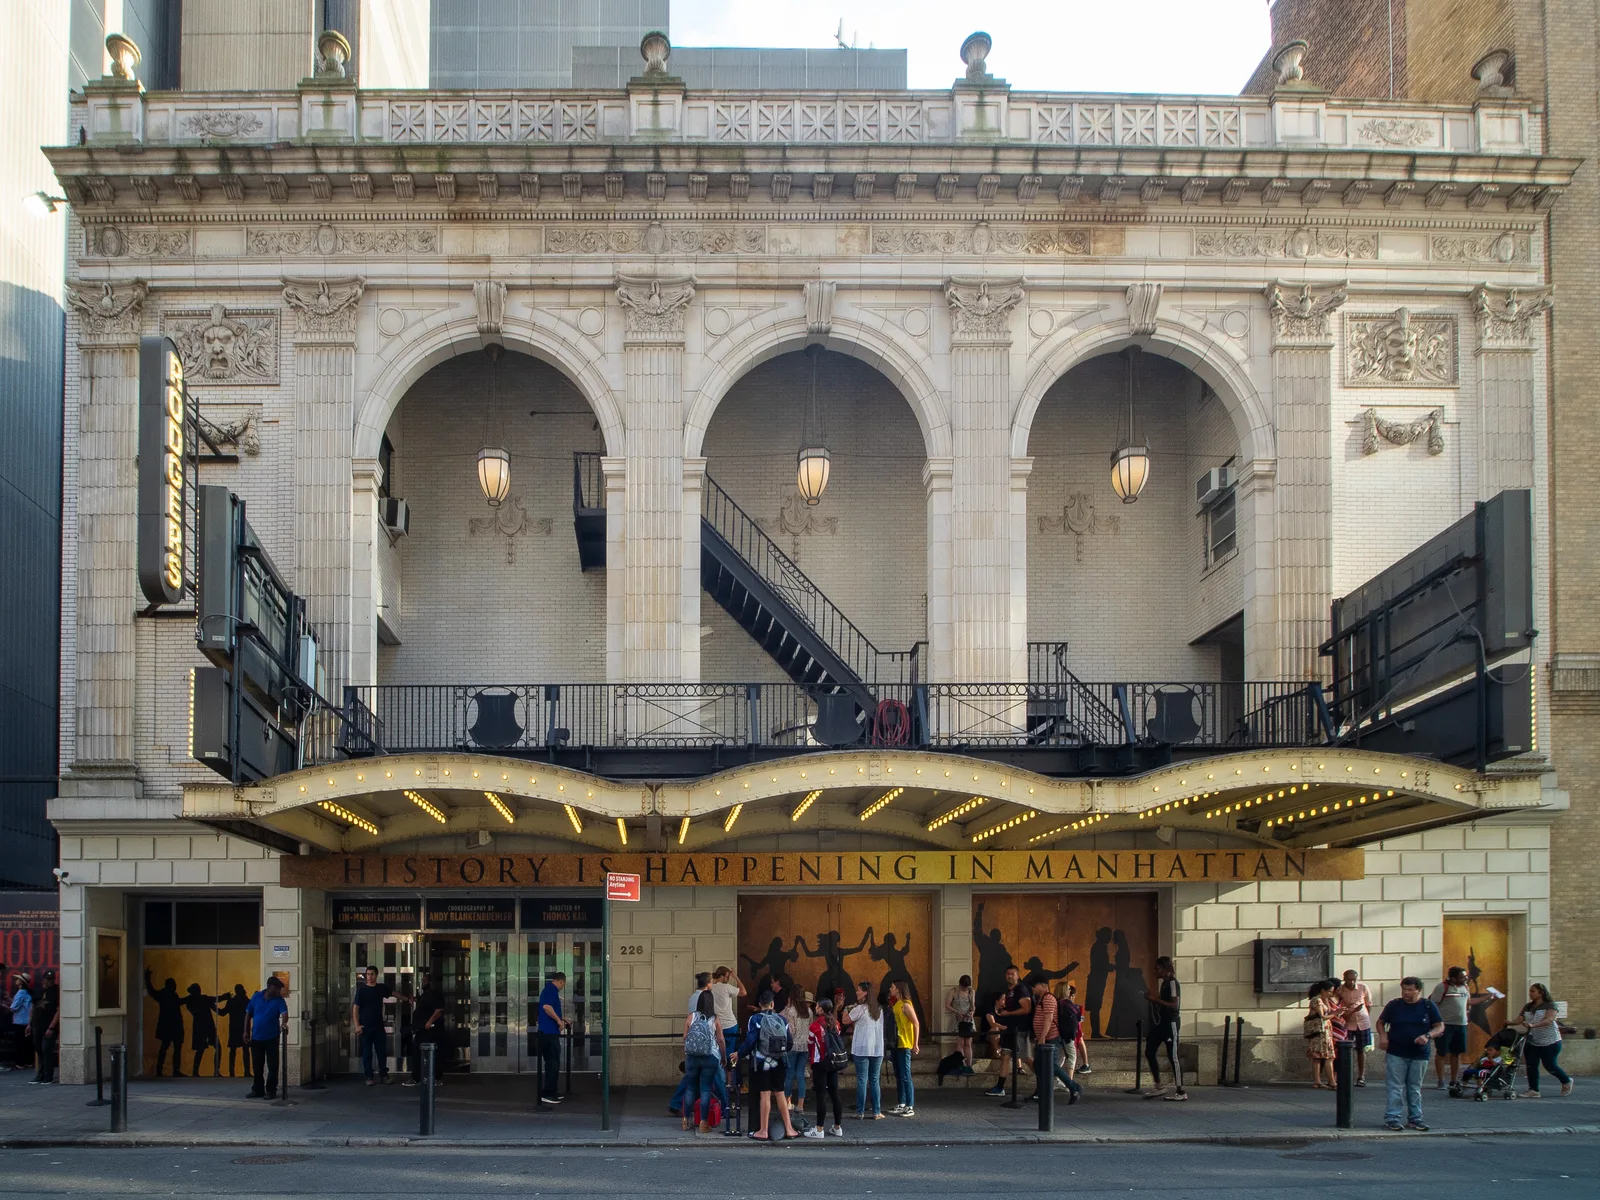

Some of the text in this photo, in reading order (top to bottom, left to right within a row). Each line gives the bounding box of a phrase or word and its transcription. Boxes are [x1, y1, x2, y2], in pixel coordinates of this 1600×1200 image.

[165, 350, 183, 590] RODGERS
[343, 852, 1307, 884] HISTORY IS HAPPENING IN MANHATTAN
[338, 912, 416, 922] LIN-MANUEL MIRANDA
[429, 911, 513, 921] ANDY BLANKENBUEHLER
[542, 911, 571, 921] THOMAS
[0, 929, 60, 968] OUL
[620, 945, 644, 955] 226
